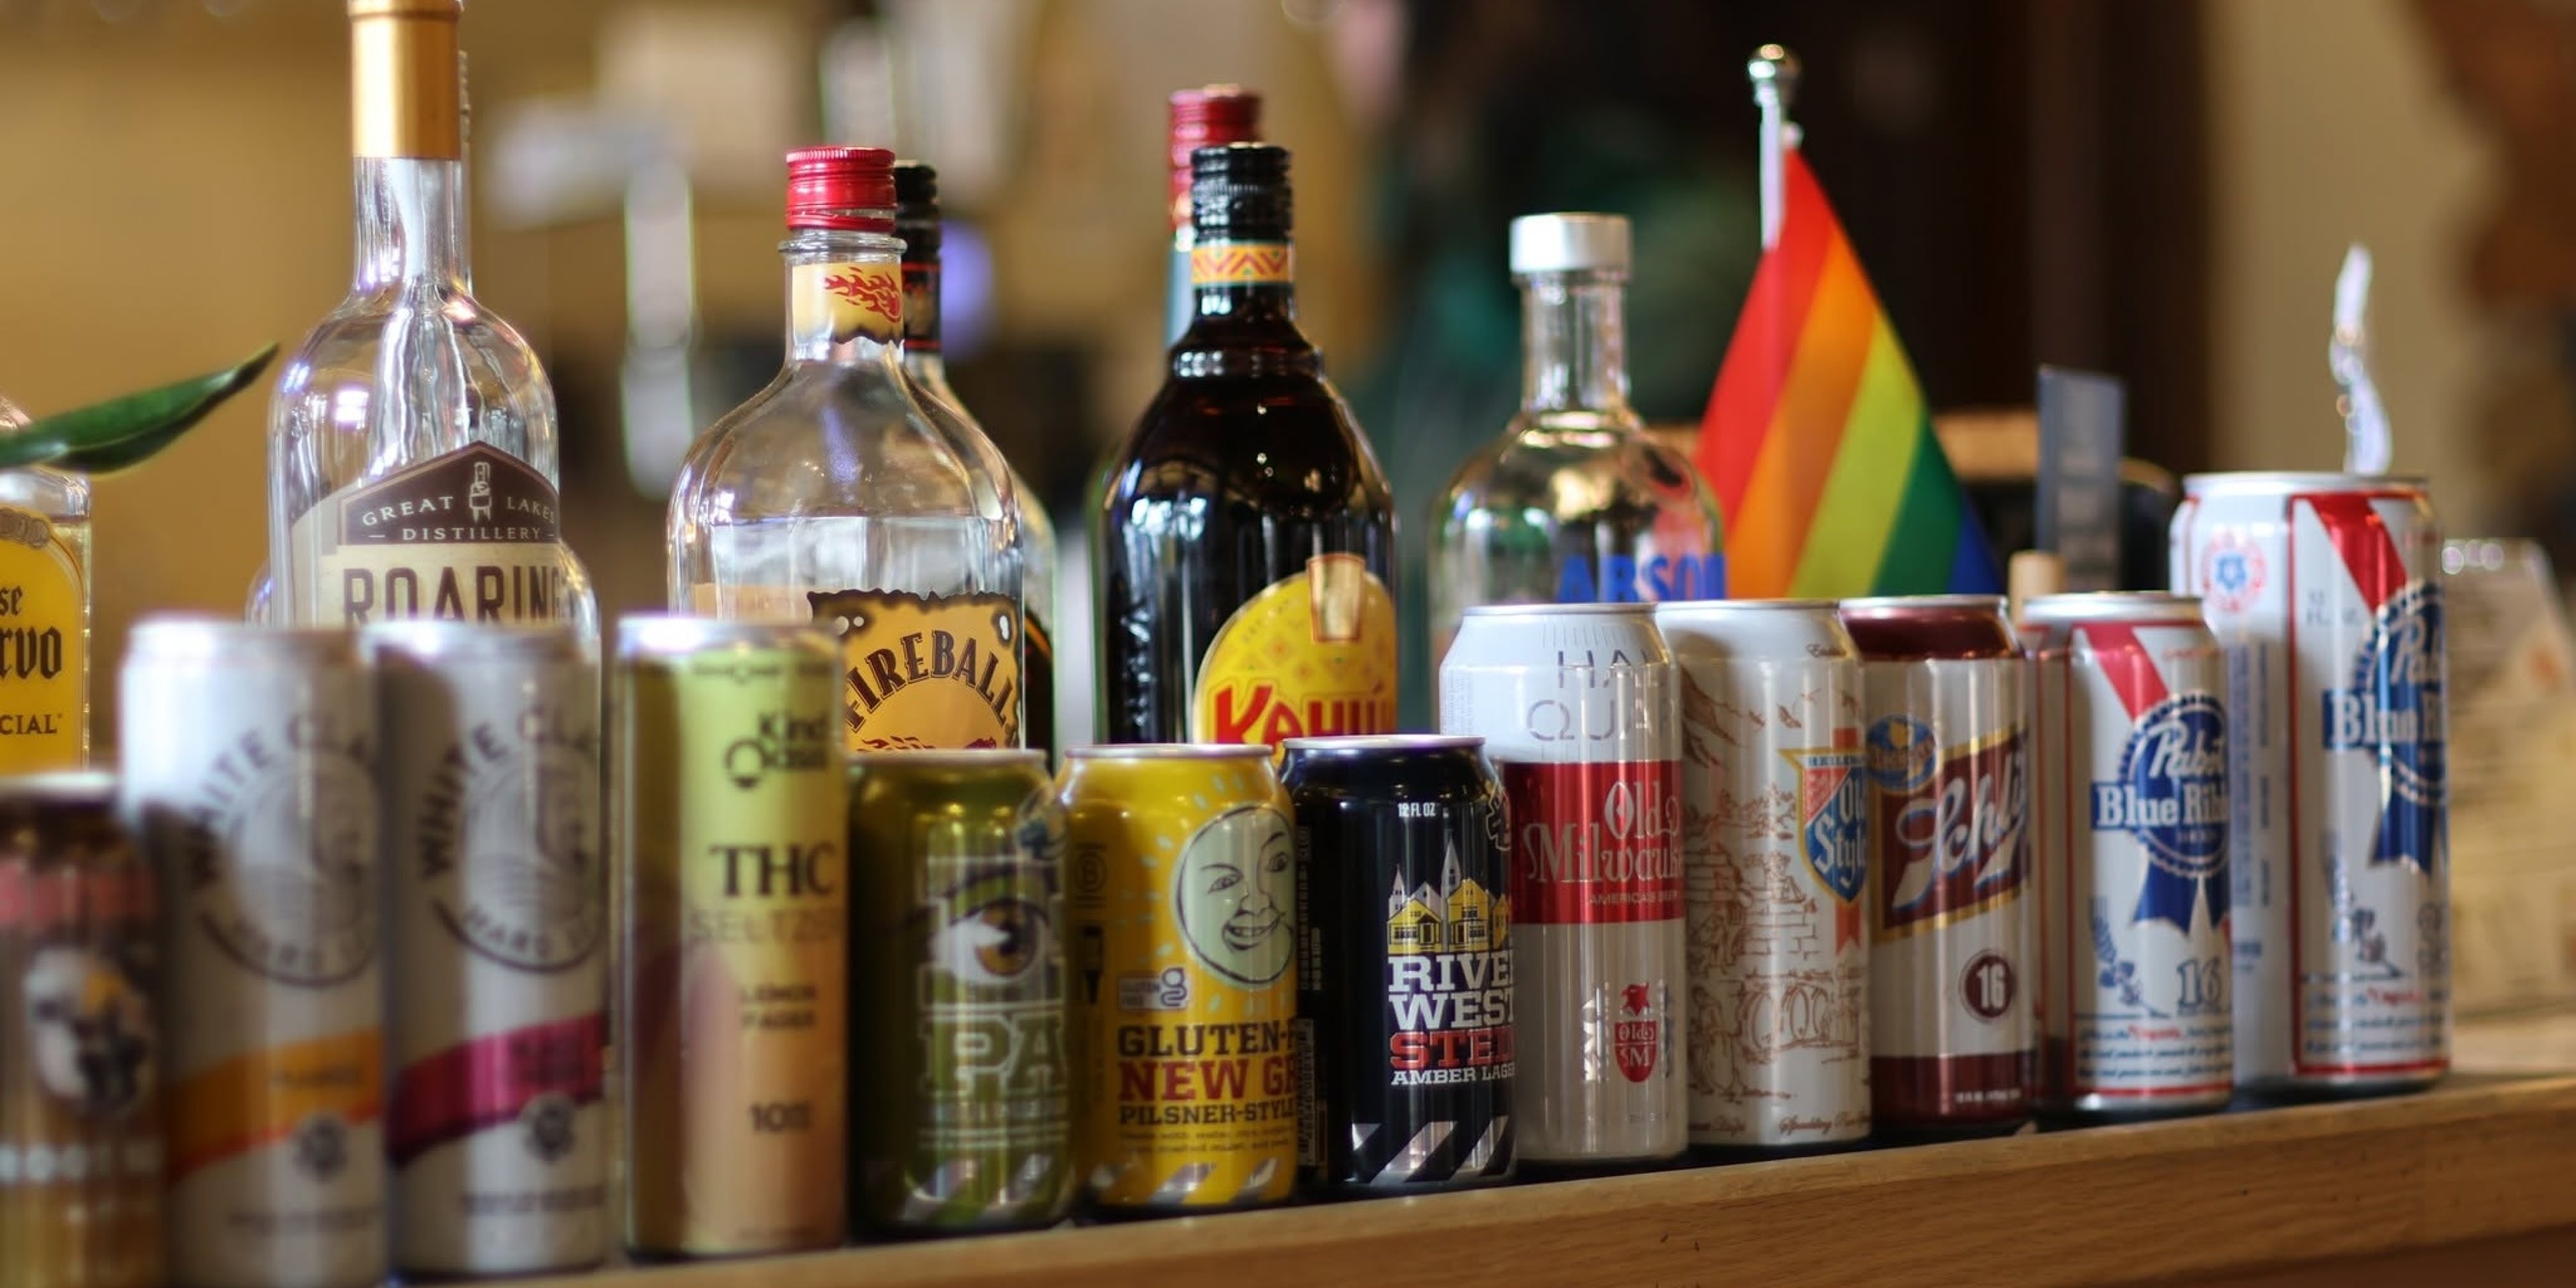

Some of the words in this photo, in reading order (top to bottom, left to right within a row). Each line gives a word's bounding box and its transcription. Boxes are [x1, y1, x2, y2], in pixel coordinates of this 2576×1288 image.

[362, 496, 453, 527] GREAT
[507, 496, 555, 524] LAKES
[402, 527, 541, 541] DISTILLERY
[1411, 802, 1421, 817] FL
[1423, 802, 1436, 817] OZ
[1604, 780, 1678, 839] Old
[2095, 782, 2179, 826] Blue
[709, 842, 836, 896] THC
[1976, 963, 2006, 1010] 16
[2178, 957, 2221, 1010] 16
[1118, 1059, 1249, 1102] NEW
[1391, 1067, 1477, 1085] AMBER
